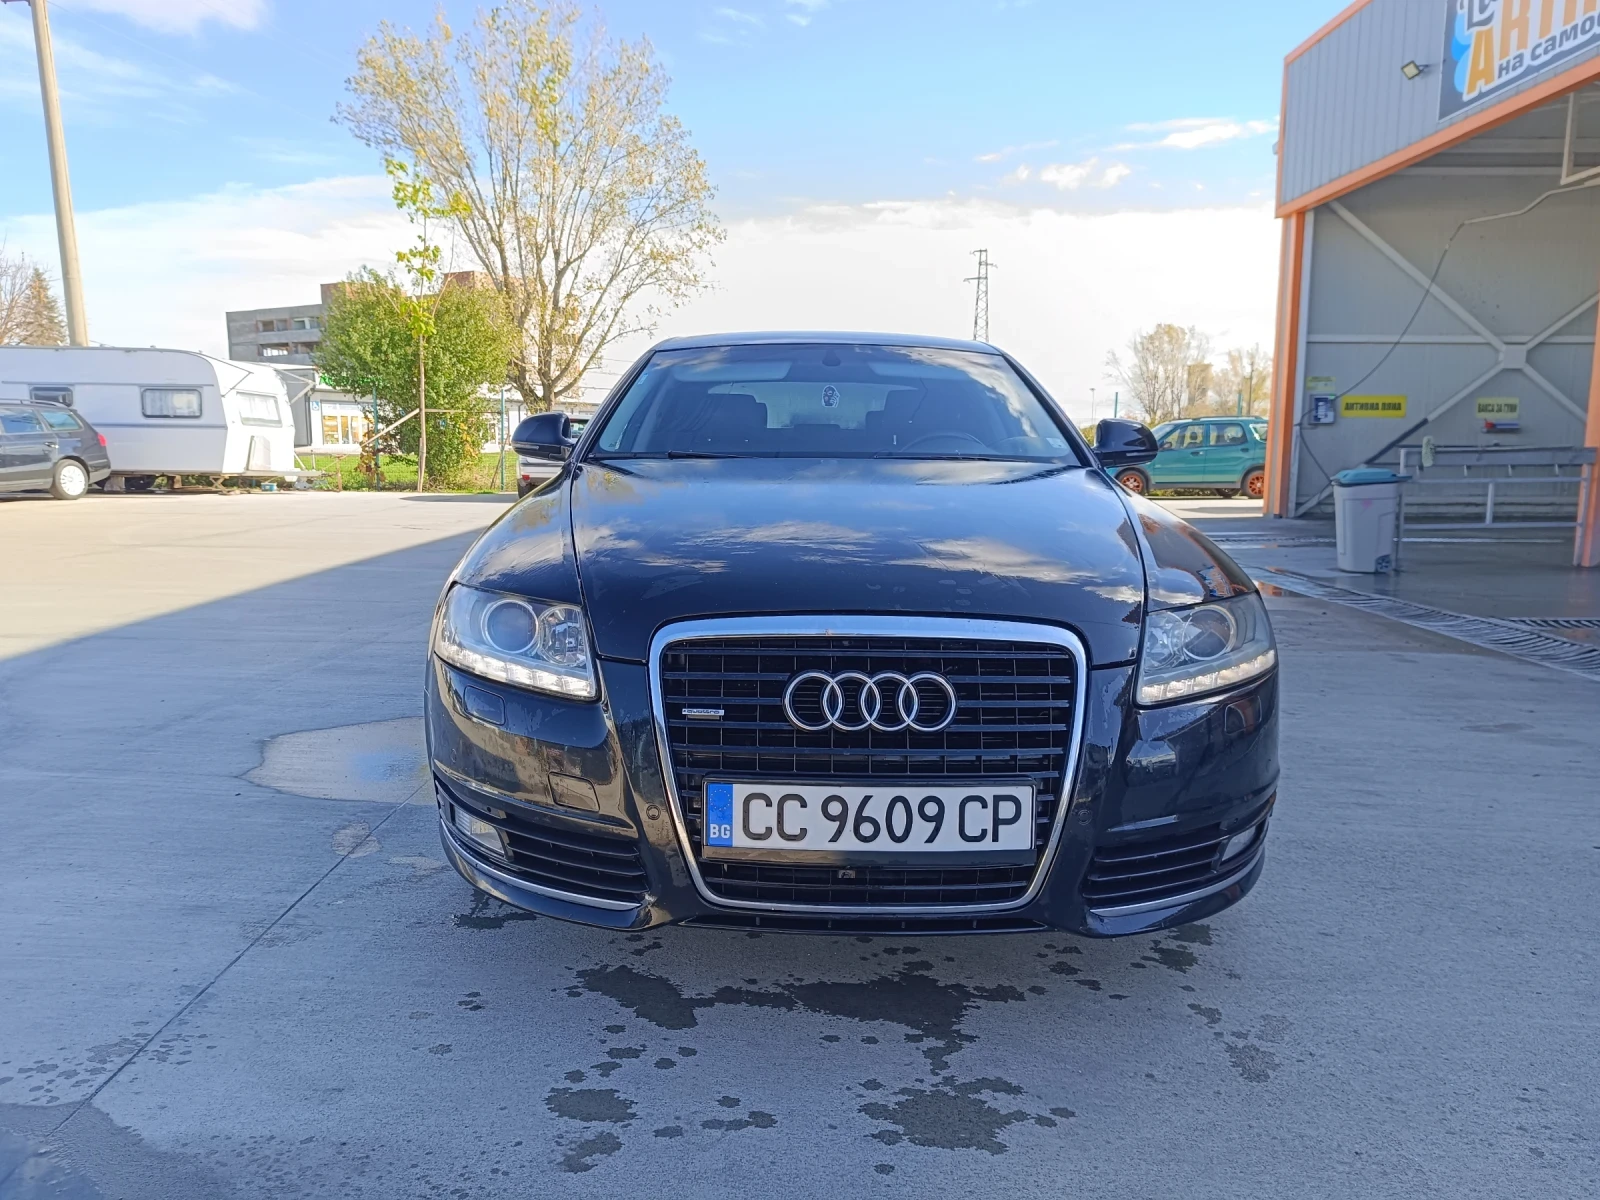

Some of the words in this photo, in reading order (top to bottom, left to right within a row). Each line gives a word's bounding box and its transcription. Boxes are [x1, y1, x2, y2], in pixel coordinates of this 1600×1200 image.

[1497, 52, 1525, 79] на
[1530, 11, 1600, 61] само
[709, 824, 731, 839] BG
[742, 792, 808, 841] CC
[821, 794, 946, 844] 9609
[957, 794, 1022, 843] CP
